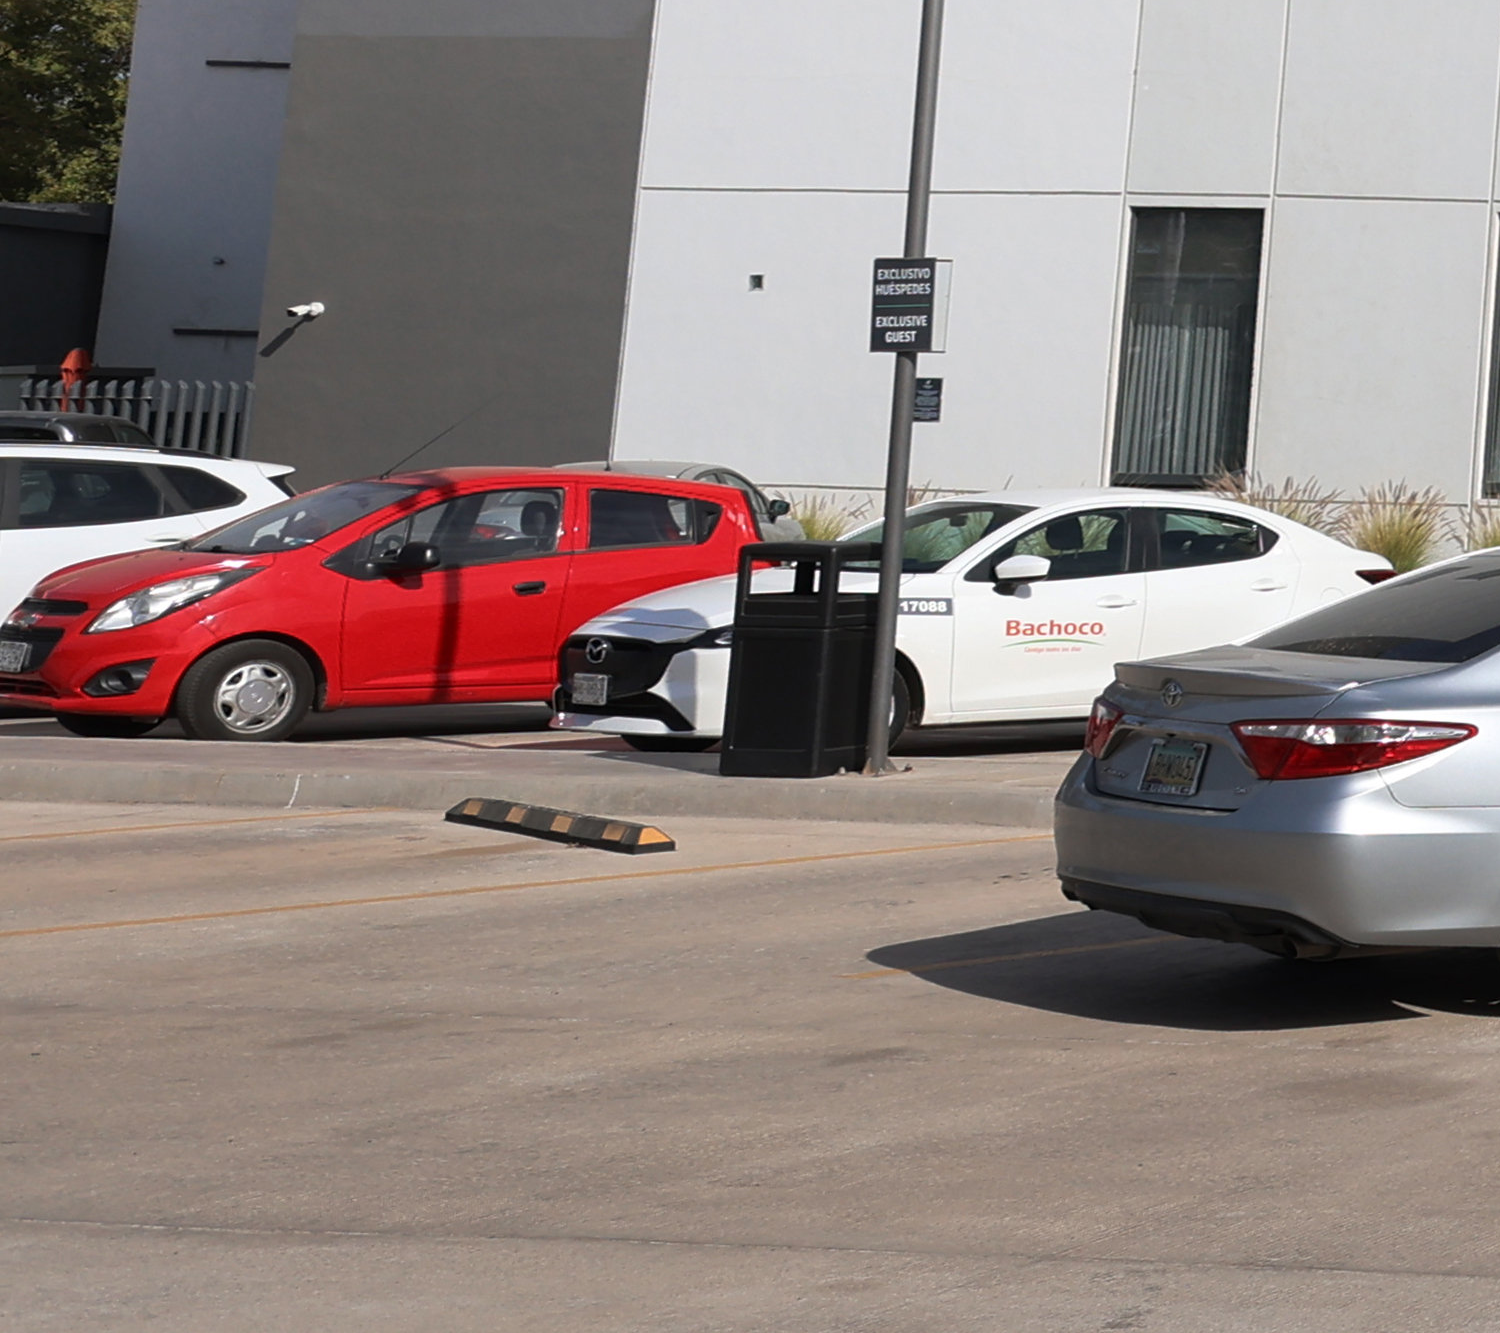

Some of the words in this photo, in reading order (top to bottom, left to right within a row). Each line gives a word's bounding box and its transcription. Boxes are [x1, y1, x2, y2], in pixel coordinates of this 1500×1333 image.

[877, 268, 931, 280] EXCLUSIVO
[875, 281, 931, 295] HUÉSPEDES
[875, 315, 928, 328] EXCLUSIVE
[885, 331, 917, 343] GUEST
[900, 600, 947, 612] 17088
[1005, 619, 1104, 637] Bachoco
